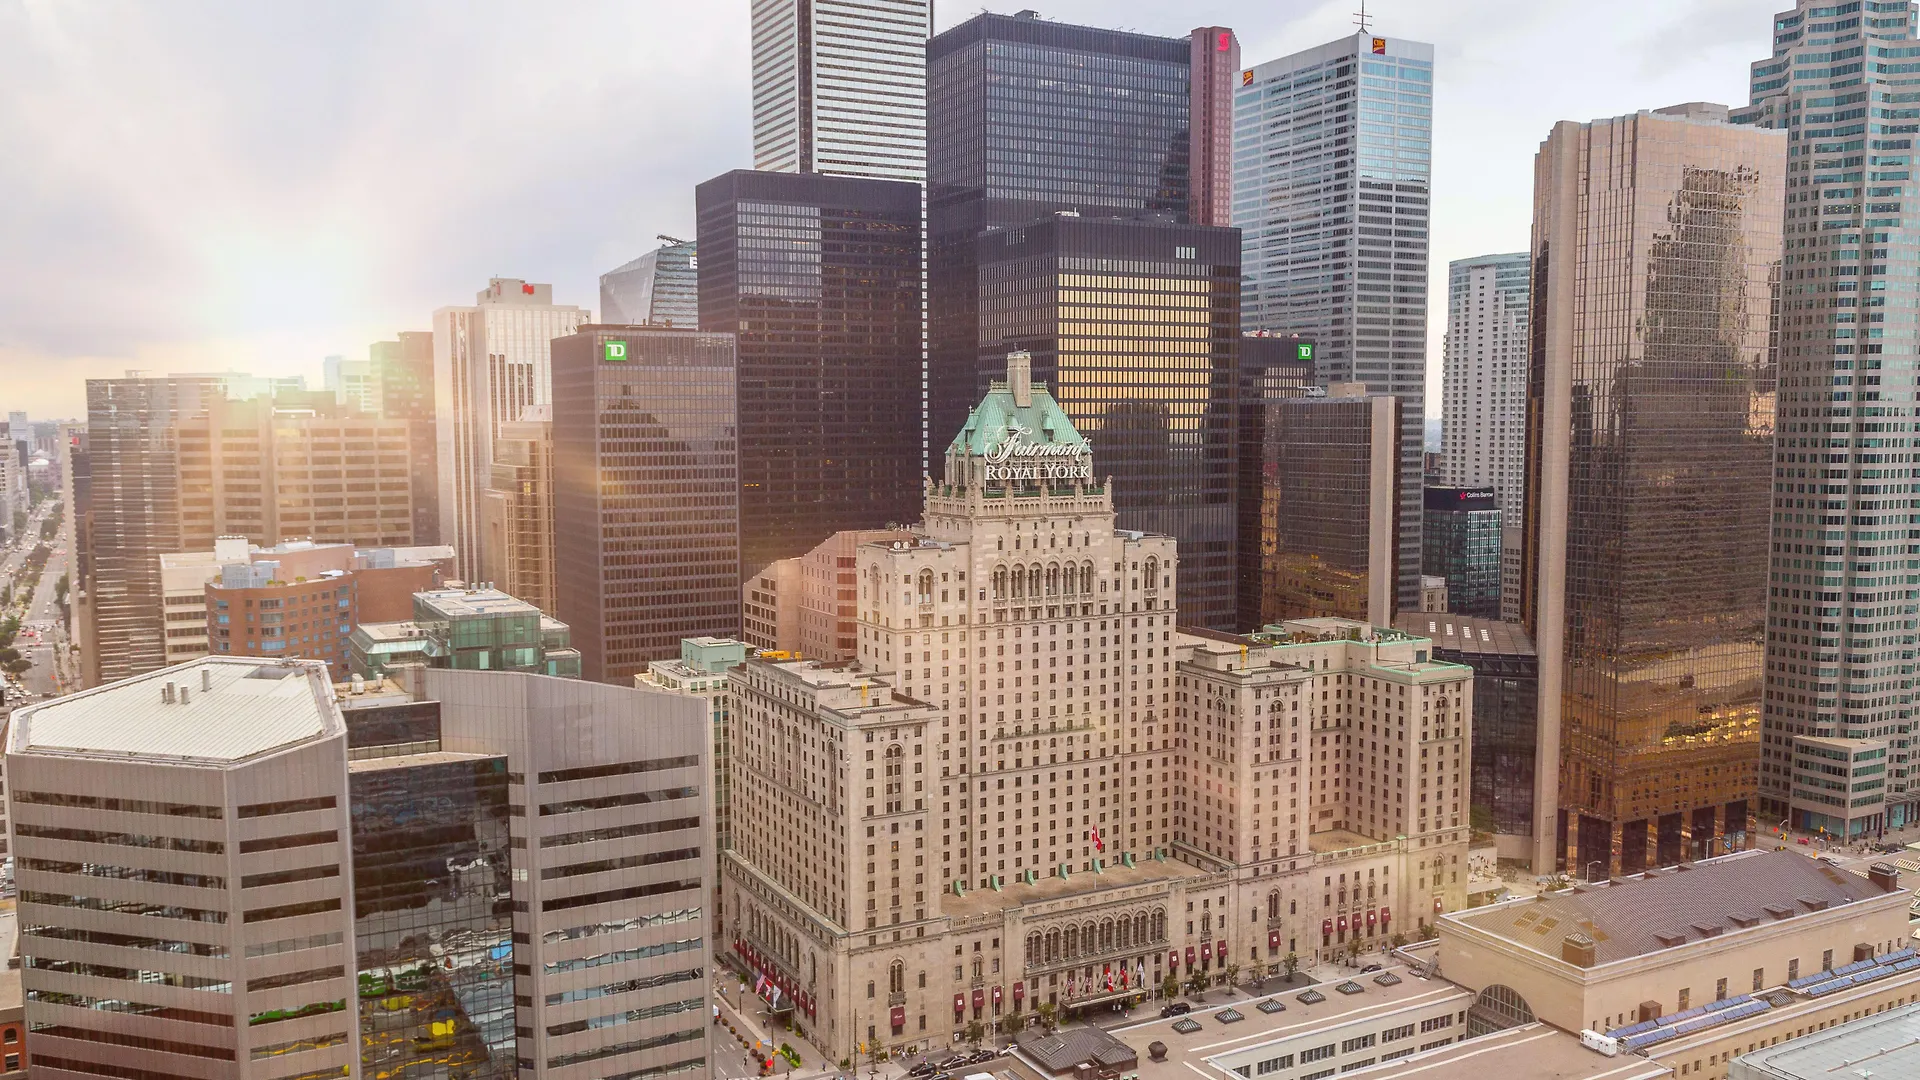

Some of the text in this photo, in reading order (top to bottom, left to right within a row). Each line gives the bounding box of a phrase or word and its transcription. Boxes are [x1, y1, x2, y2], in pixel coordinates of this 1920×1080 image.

[606, 344, 625, 357] TD
[1299, 346, 1311, 357] TD
[984, 424, 1092, 463] Fairmont
[986, 464, 1089, 480] ROYAL YORK
